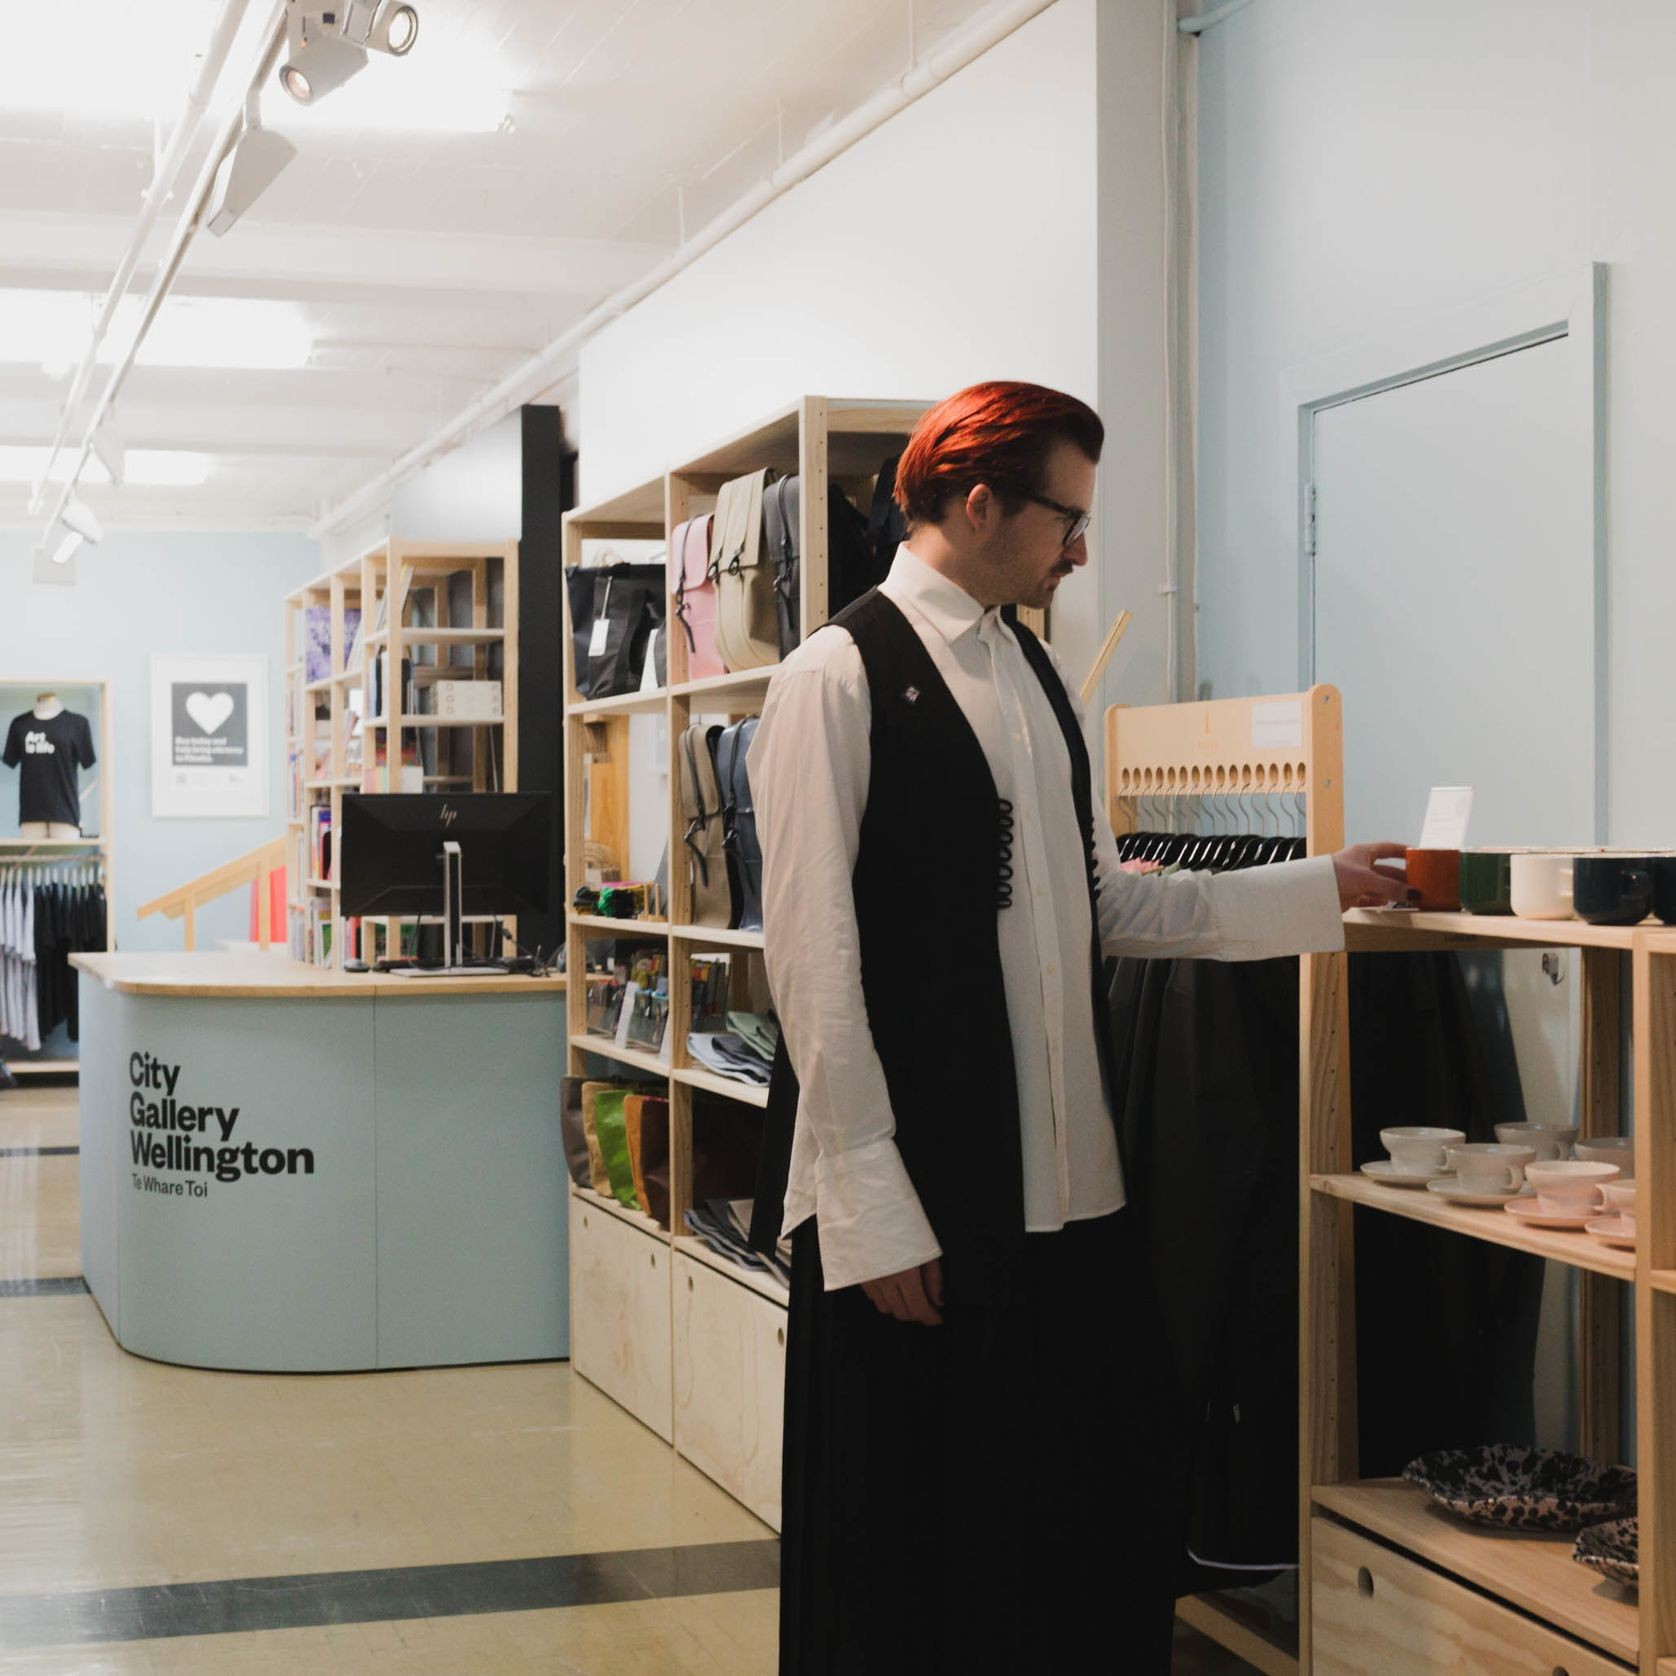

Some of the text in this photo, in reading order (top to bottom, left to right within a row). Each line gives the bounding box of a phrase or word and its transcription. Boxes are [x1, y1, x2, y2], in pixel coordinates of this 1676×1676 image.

[25, 730, 46, 742] Art
[36, 740, 55, 754] life
[440, 803, 457, 827] hp
[130, 1051, 181, 1097] City
[130, 1091, 240, 1142] Gallery
[131, 1129, 315, 1182] Wellington
[132, 1173, 208, 1198] Te Whare Toi
